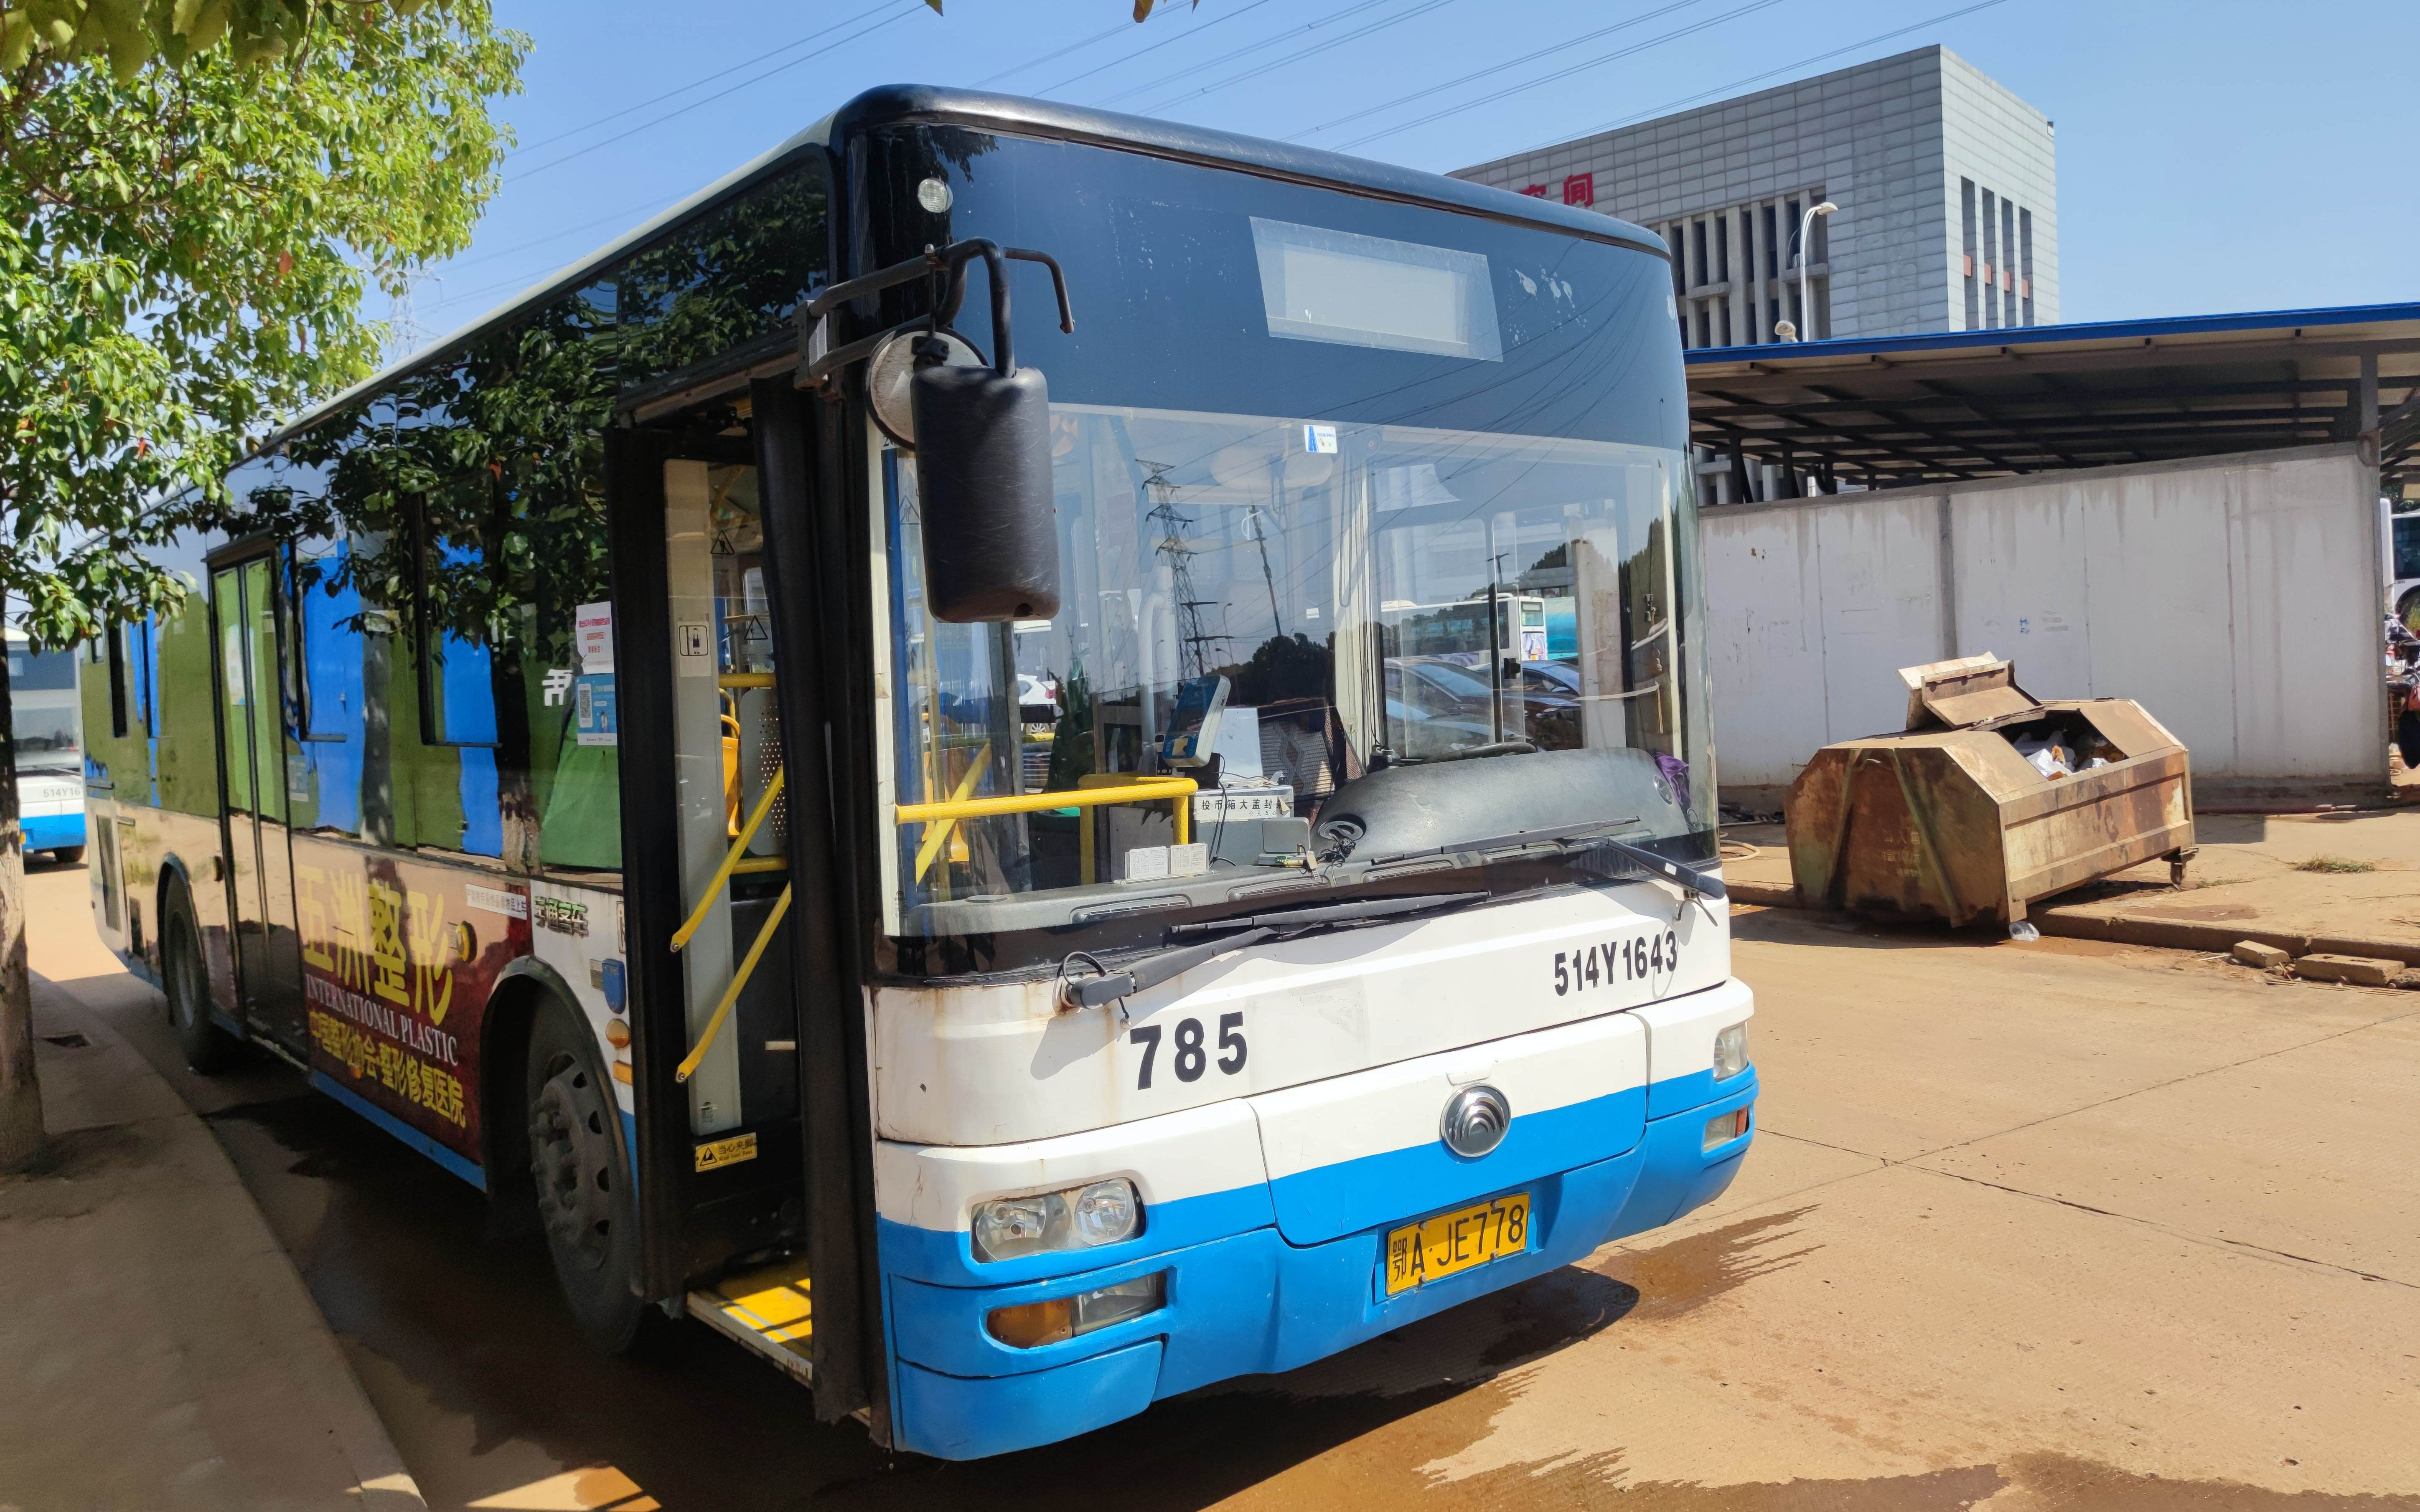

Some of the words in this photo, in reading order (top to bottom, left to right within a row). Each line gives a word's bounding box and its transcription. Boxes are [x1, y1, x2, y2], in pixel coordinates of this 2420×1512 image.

[297, 865, 453, 1026] 五洲整形
[534, 896, 588, 937] 宇通客车
[1554, 931, 1677, 996] 514Y1643
[305, 973, 399, 1039] INTERNATIONAL
[399, 1014, 459, 1067] PLASTIC
[1130, 1011, 1247, 1090] 785
